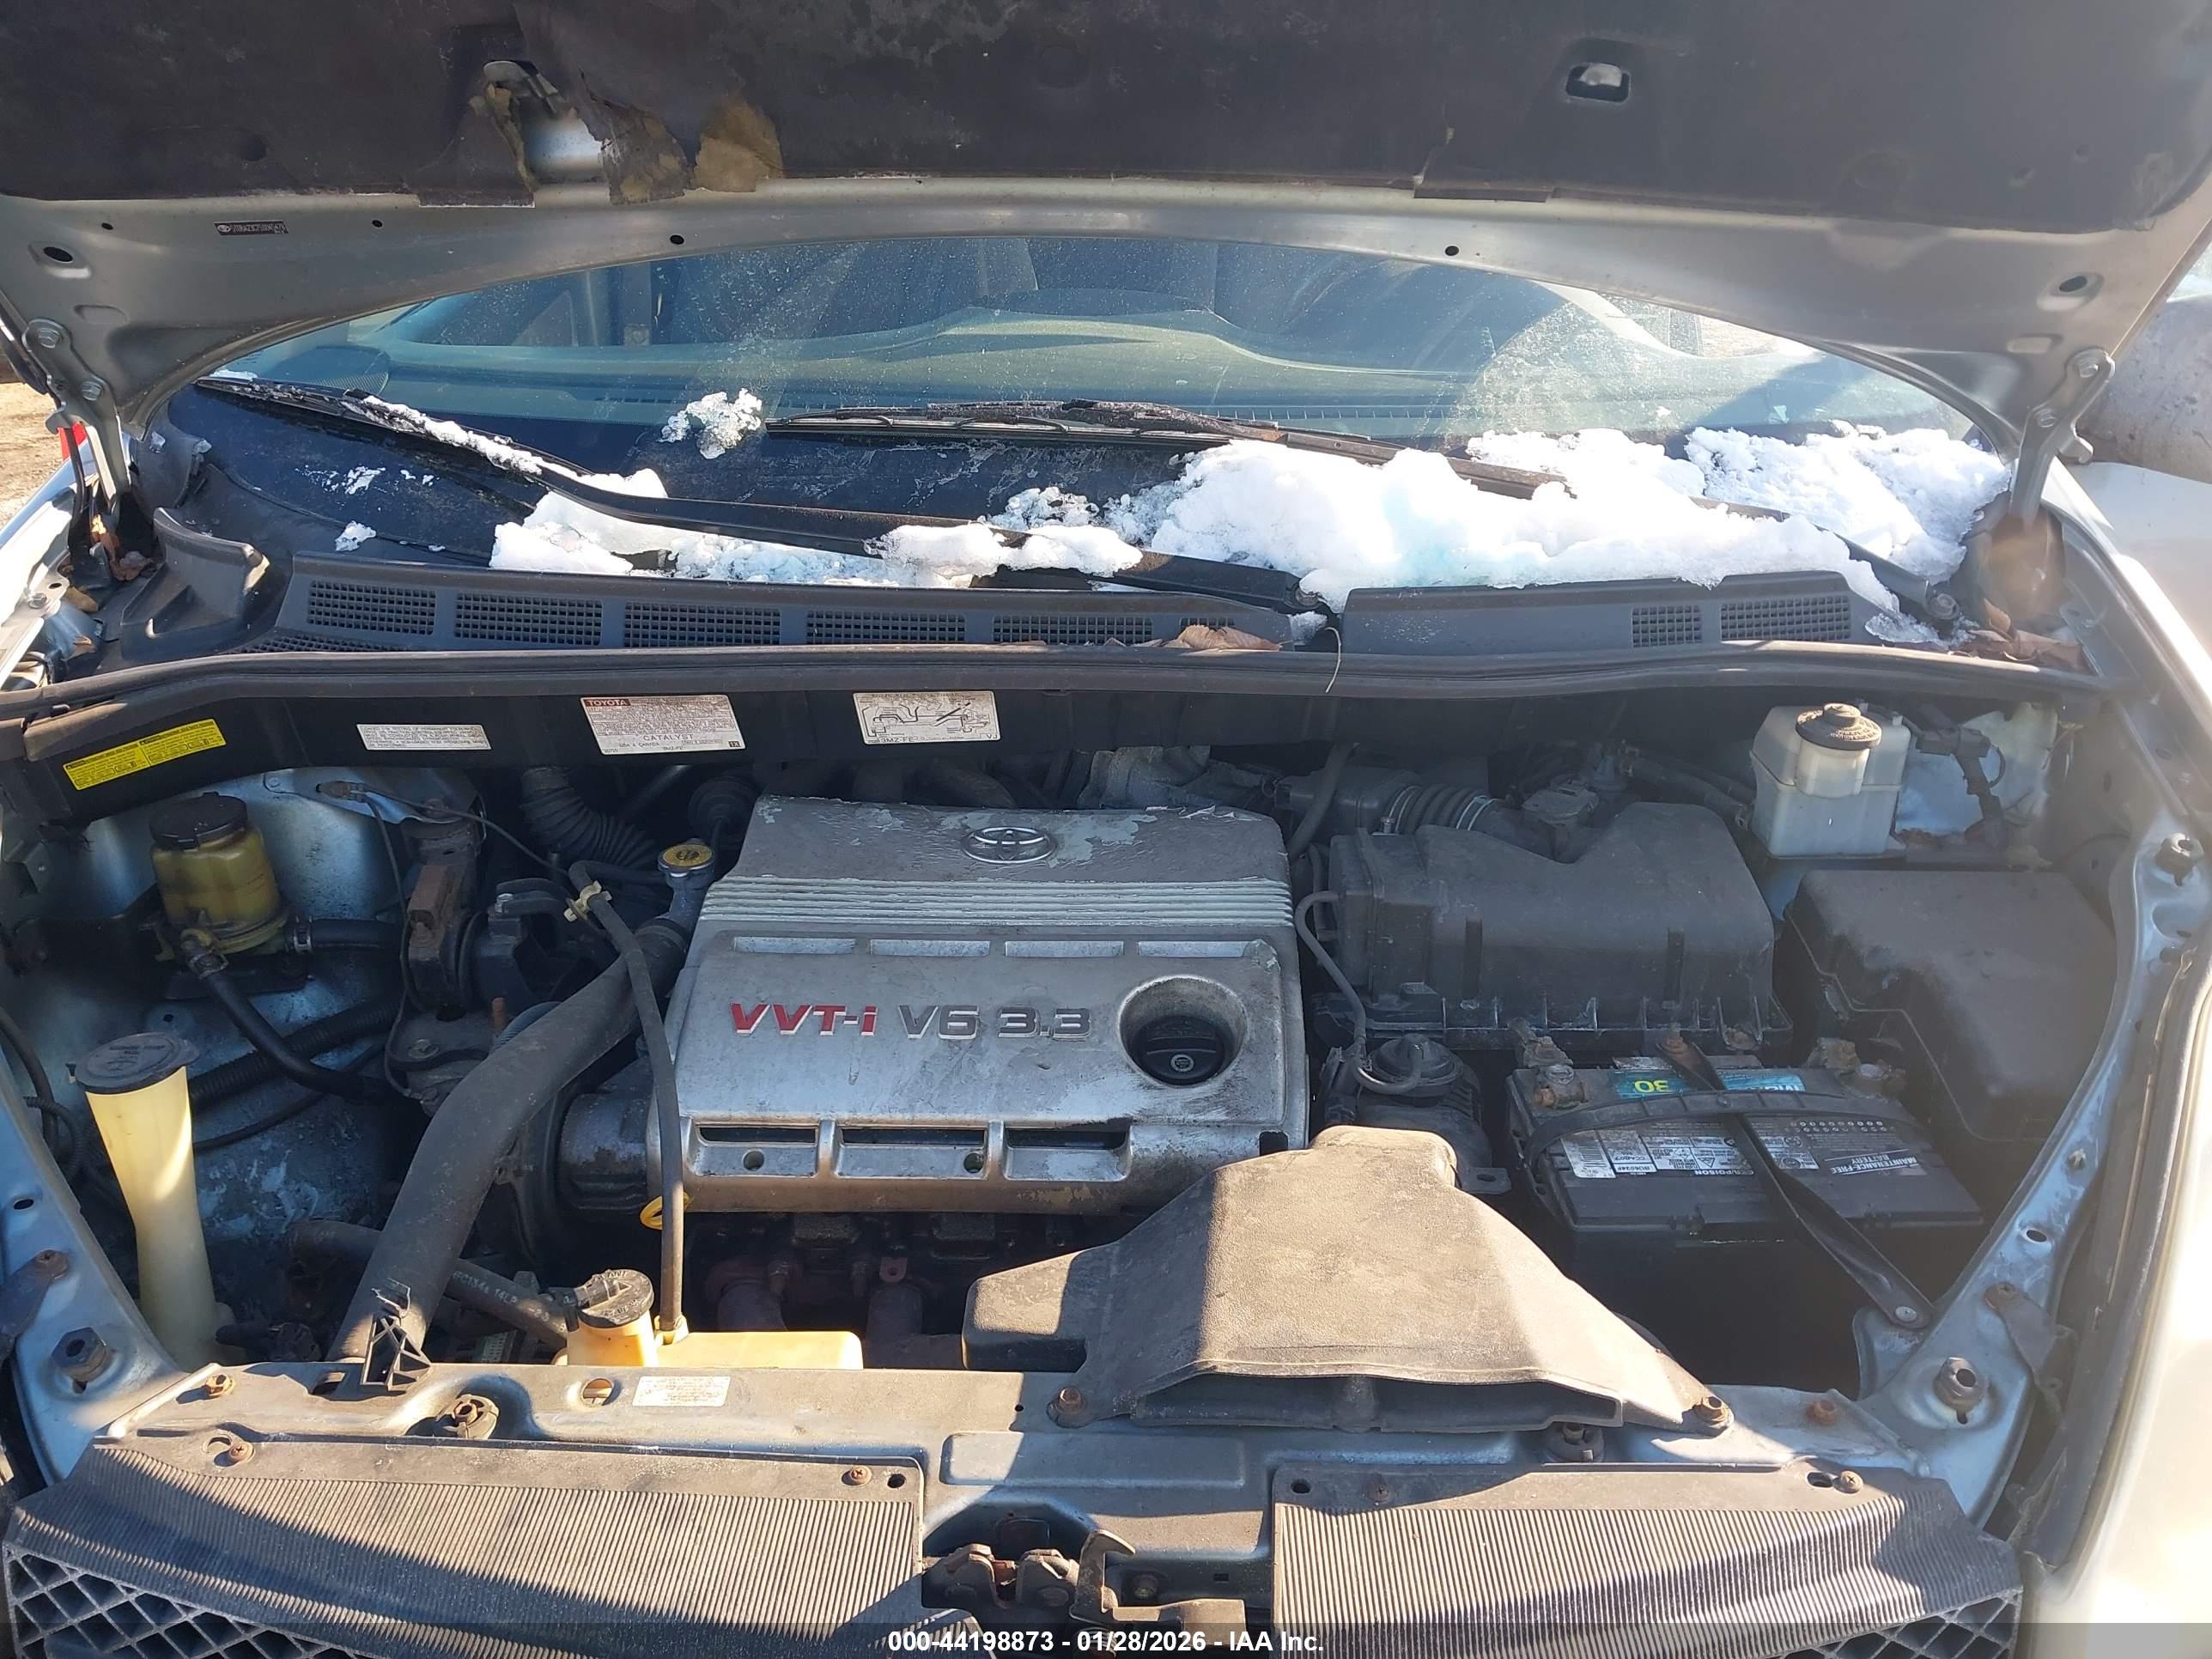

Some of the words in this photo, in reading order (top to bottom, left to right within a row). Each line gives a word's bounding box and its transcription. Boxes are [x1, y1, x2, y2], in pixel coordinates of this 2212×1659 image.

[643, 733, 695, 742] CATALYST
[730, 1002, 878, 1036] VVT-i
[897, 1004, 981, 1040] V6
[997, 1004, 1093, 1042] 3.3
[1829, 1156, 1918, 1175] MAINTENANCE-FREE
[1850, 1154, 1891, 1165] BATTERY
